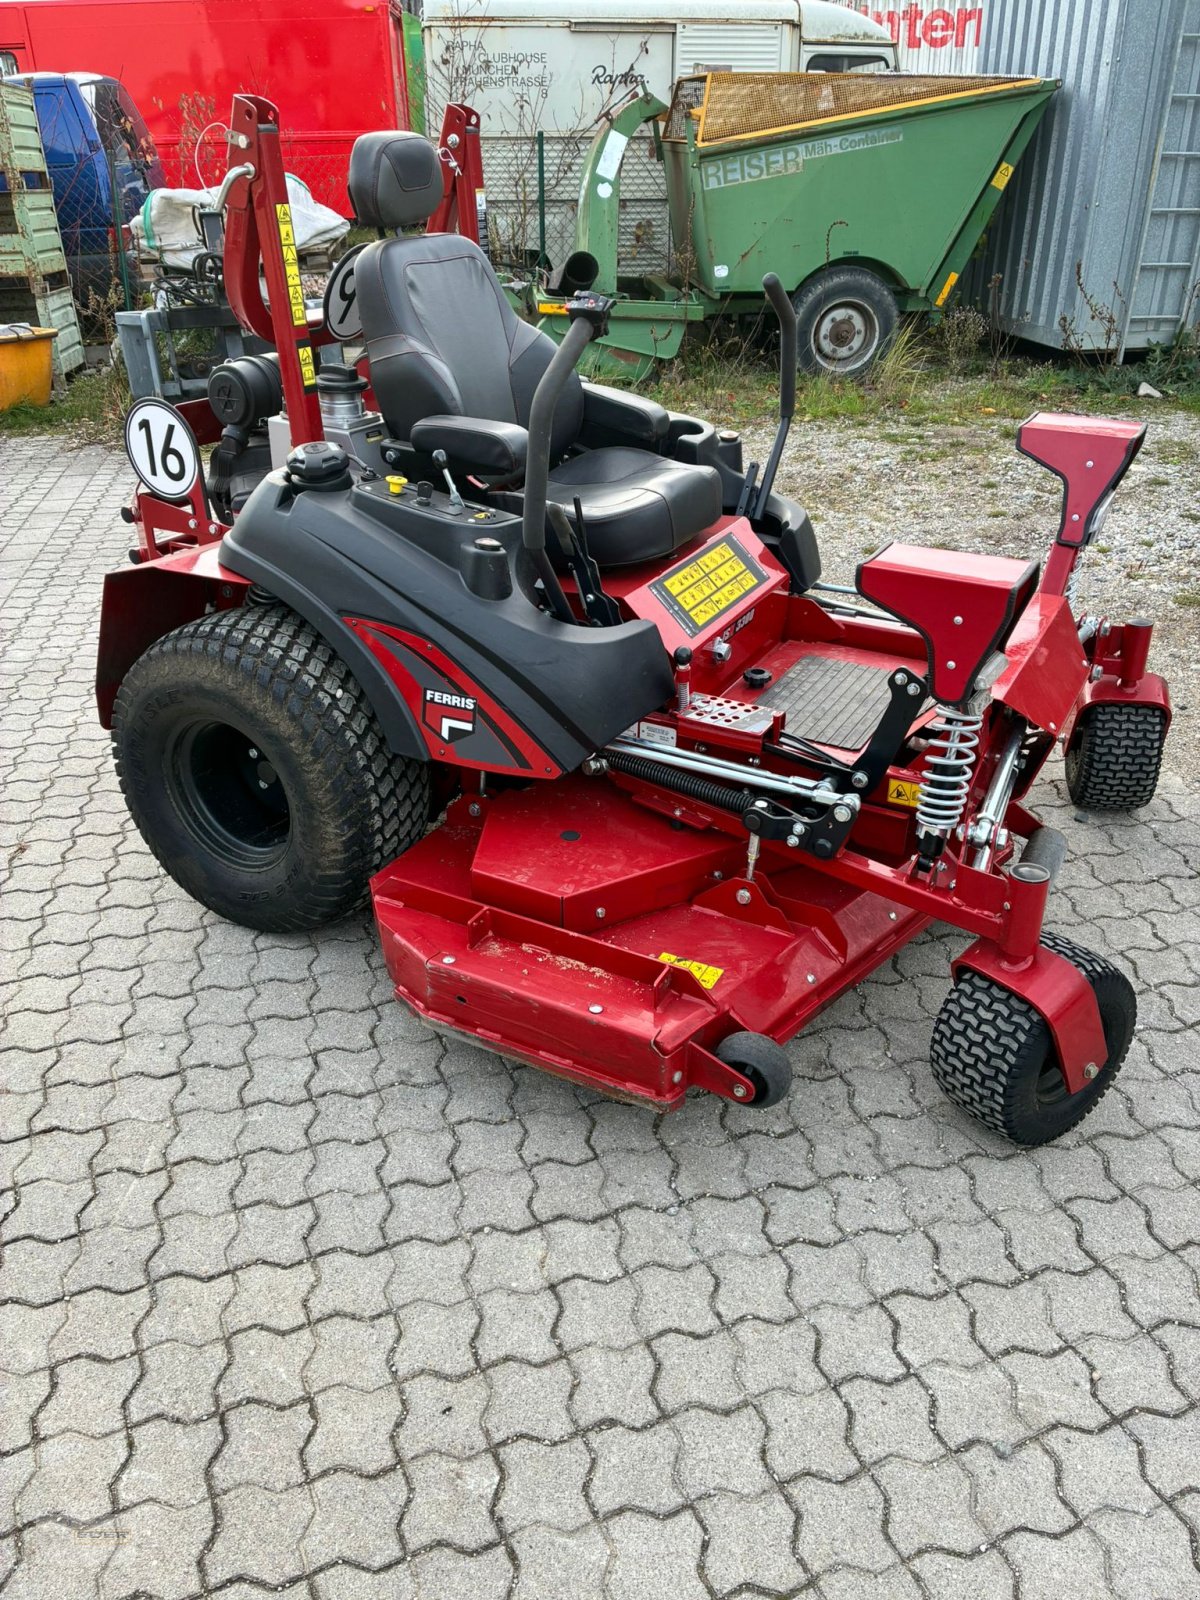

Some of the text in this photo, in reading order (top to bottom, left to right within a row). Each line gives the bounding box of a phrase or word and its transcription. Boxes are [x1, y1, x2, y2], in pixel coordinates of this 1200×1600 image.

[477, 52, 548, 64] CLUBHOUSE
[541, 88, 548, 99] 8
[703, 147, 803, 188] REISER
[138, 418, 185, 482] 16
[426, 689, 475, 710] FERRIS
